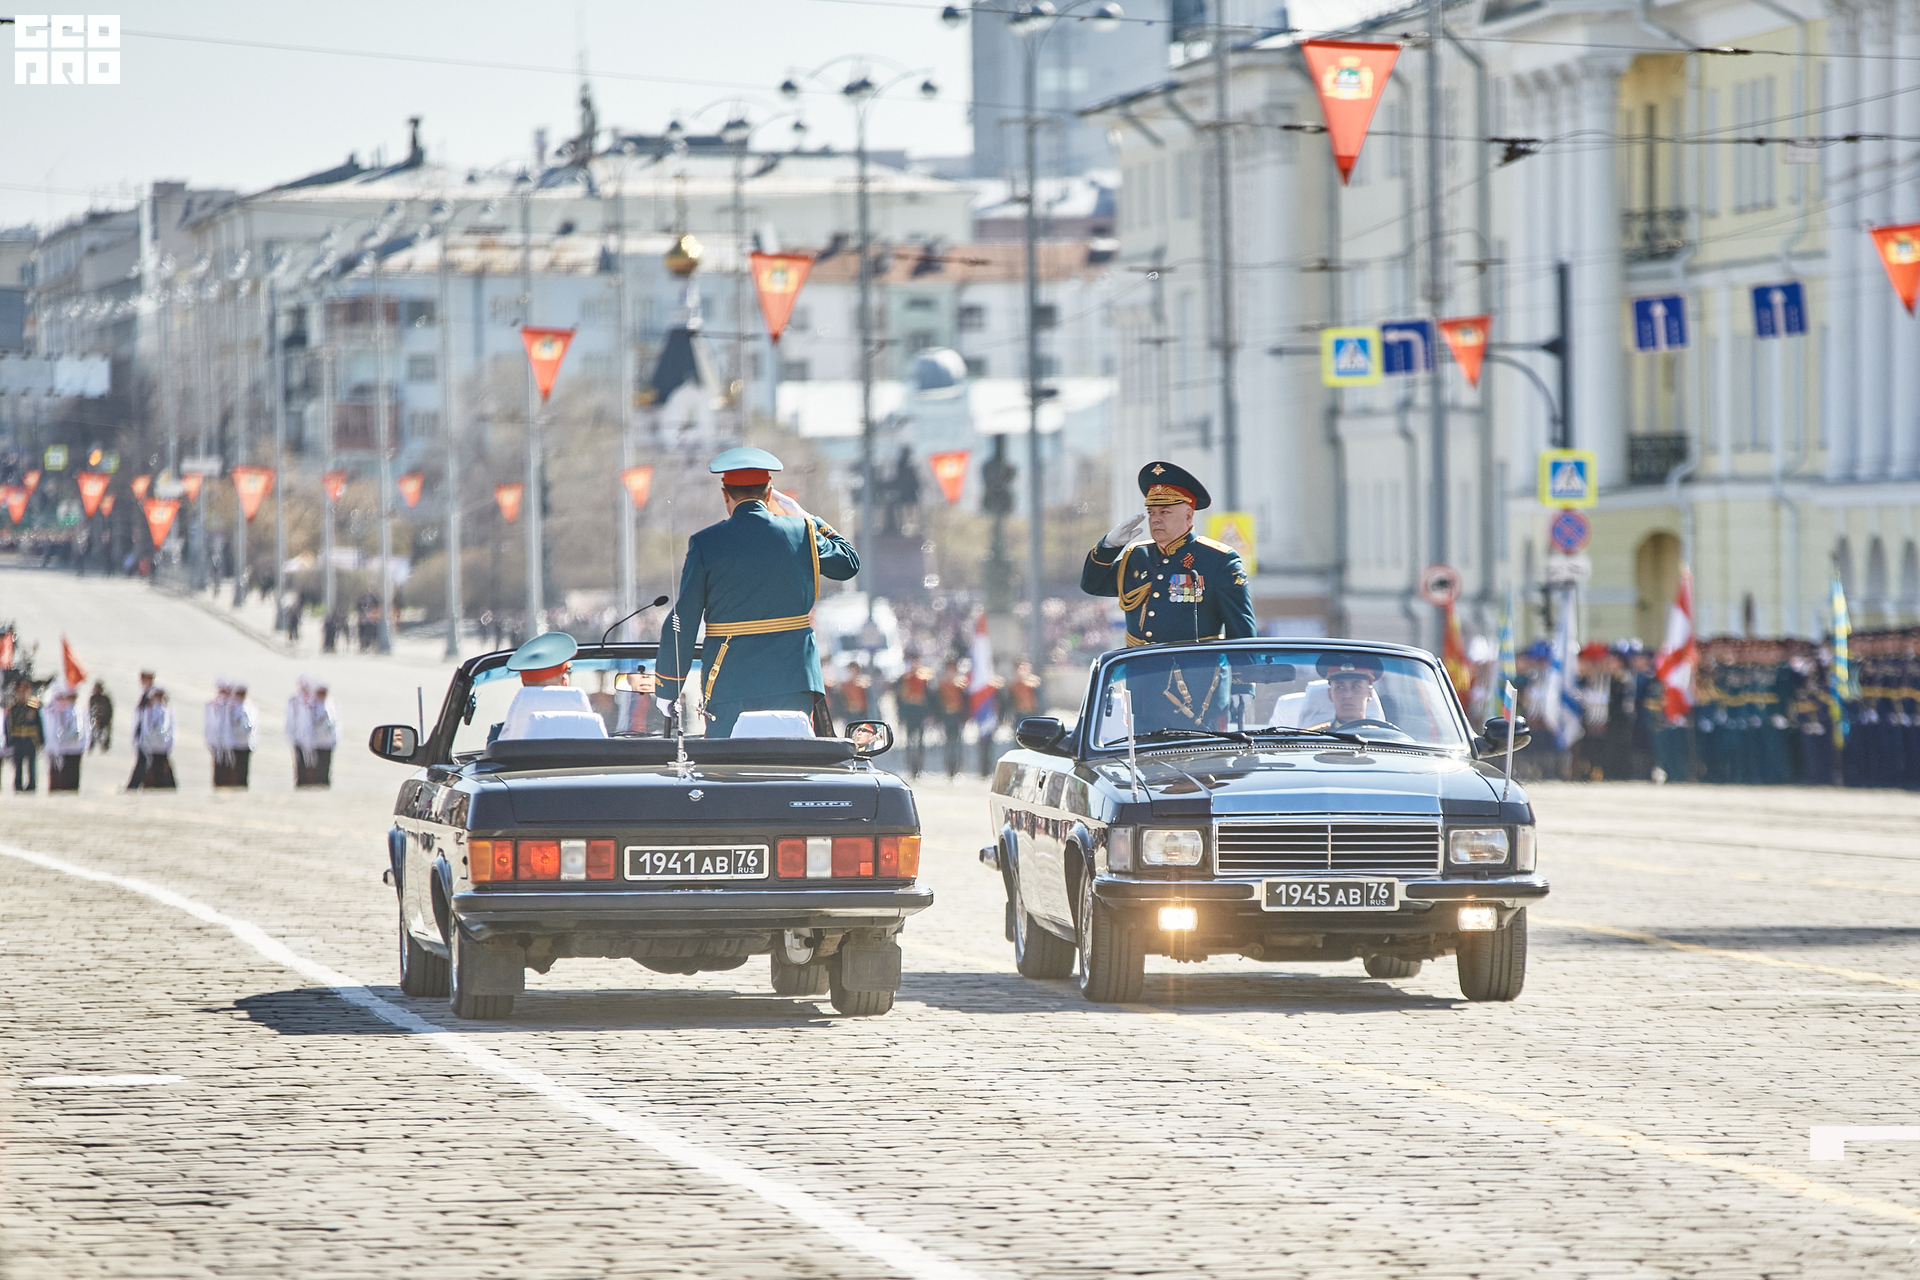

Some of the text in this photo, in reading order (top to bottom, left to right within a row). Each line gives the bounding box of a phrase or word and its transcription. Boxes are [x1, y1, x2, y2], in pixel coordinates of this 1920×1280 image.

[639, 852, 695, 874] 1941
[735, 850, 758, 867] 76
[1275, 883, 1331, 905] 1945
[1367, 883, 1390, 900] 76
